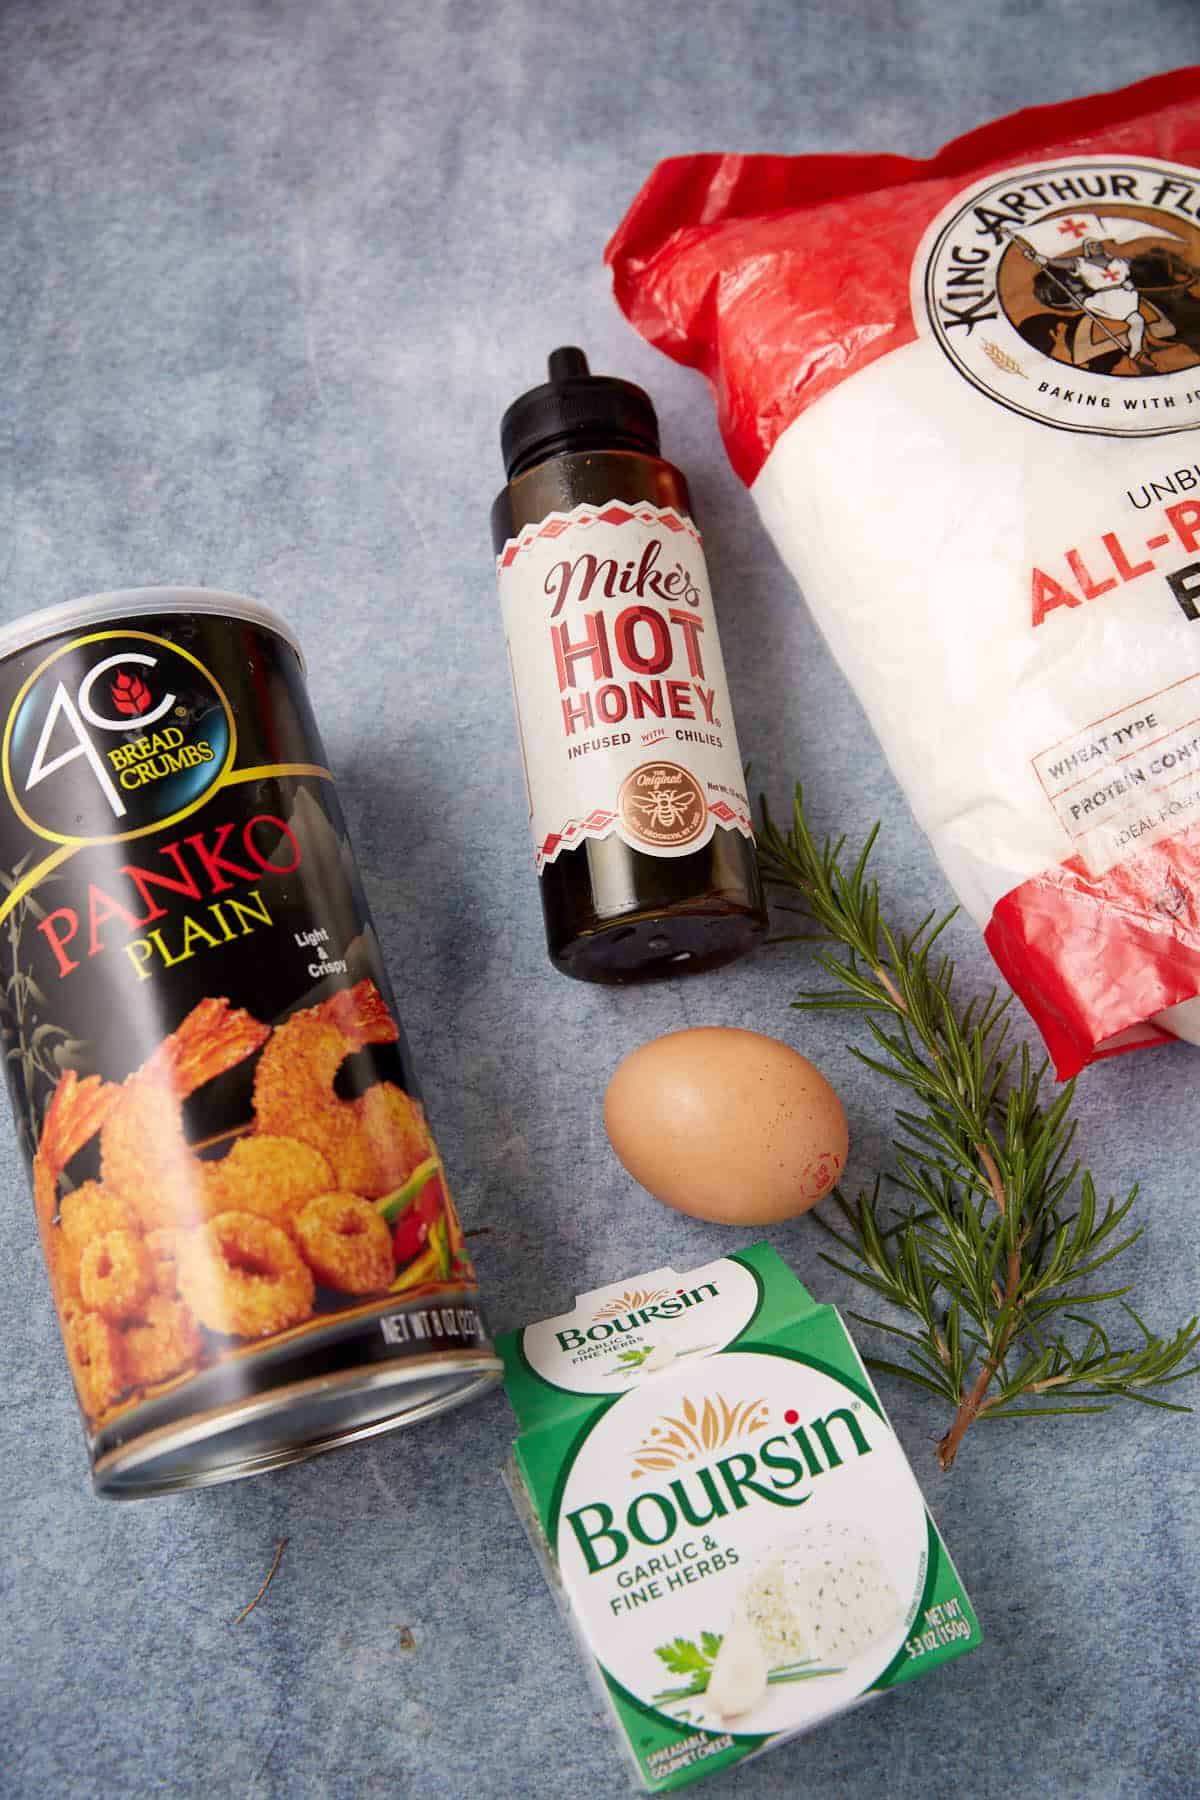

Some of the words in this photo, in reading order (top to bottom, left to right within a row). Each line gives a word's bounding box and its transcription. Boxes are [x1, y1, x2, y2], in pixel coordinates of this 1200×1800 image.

[939, 245, 998, 337] KING
[973, 174, 1143, 246] ARTHUR
[1152, 176, 1200, 221] FL
[1038, 381, 1111, 408] BAKING
[1123, 396, 1176, 410] WITH
[544, 540, 701, 618] Mike's
[551, 605, 705, 693] HOT
[561, 679, 715, 737] HONEY
[107, 727, 184, 771] BREAD
[120, 741, 214, 789] CRUMBS
[568, 732, 631, 760] INFUSED
[641, 727, 665, 742] WITH
[675, 729, 723, 749] CHILIES
[1048, 738, 1111, 779] WHEAT
[1112, 713, 1158, 744] TYPE
[637, 772, 682, 789] Original
[1070, 768, 1146, 820] PROTEIN
[37, 815, 300, 979] PANKO
[121, 891, 273, 982] PLAIN
[294, 928, 329, 947] Light
[308, 960, 347, 978] Crispy
[609, 1581, 664, 1616] FINE
[667, 1548, 740, 1593] HERBS
[616, 1542, 698, 1588] GARLIC
[702, 1535, 719, 1551] &
[924, 1605, 945, 1627] NET
[943, 1597, 962, 1618] WT
